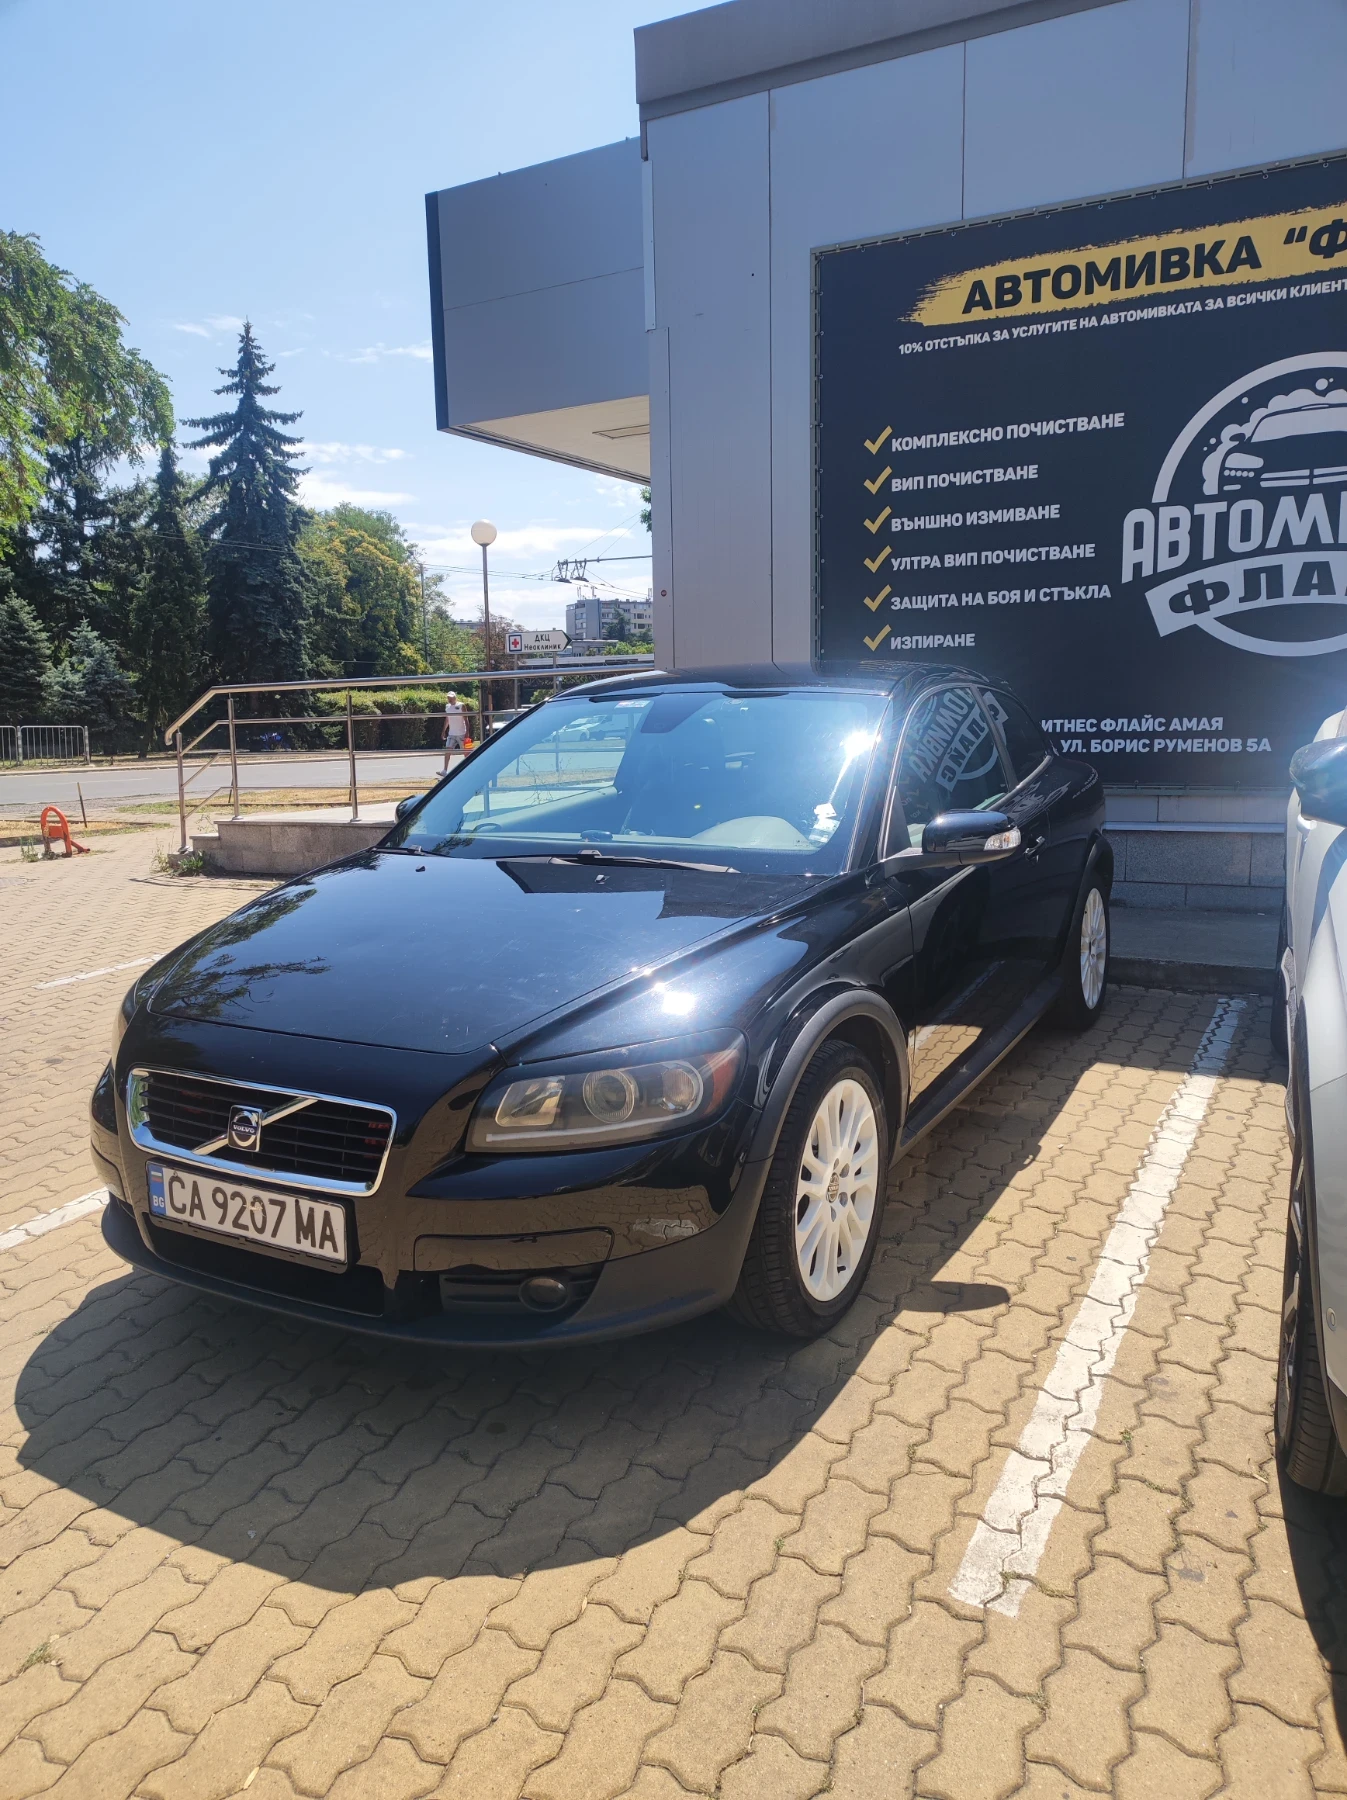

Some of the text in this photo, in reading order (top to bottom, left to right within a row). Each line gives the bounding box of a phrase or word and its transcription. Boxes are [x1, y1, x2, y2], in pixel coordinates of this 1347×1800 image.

[962, 235, 1262, 314] АВТОМИВКА
[898, 342, 923, 355] 10%
[925, 332, 991, 350] ОТСТЪПКА
[993, 329, 1010, 342] ЗА
[1012, 318, 1077, 338] УСЛУГИТЕ
[1079, 316, 1098, 329] НА
[1100, 301, 1202, 326] АВТОМИВКАТА
[1204, 297, 1224, 311] ЗА
[1226, 287, 1287, 308] ВСИЧКИ
[891, 412, 1125, 452] КОМПЛЕКСНО ПОЧИСТВАНЕ
[891, 464, 1039, 492] ВИП ПОЧИСТВАНЕ
[891, 504, 1061, 532] ВЪНШНО ИЗМИВАНЕ
[1121, 491, 1347, 584] АВТОМ
[891, 543, 1096, 571] УЛТРА ВИП ПОЧИСТВАНЕ
[890, 584, 1112, 611] ЗАЩИТА НА БОЯ И СТЪКЛА
[1168, 560, 1347, 615] ФЛА
[534, 634, 550, 642] ДКЦ
[890, 633, 976, 650] ИЗПИРАНЕ
[1100, 714, 1166, 733] ФЛАЙС
[1168, 716, 1224, 732] АМАЯ
[1060, 737, 1272, 753] УЛ. БОРИС РУМЕНОВ 5А
[232, 1124, 255, 1134] VOLVO
[153, 1195, 165, 1208] BG
[211, 1186, 287, 1239] 9207
